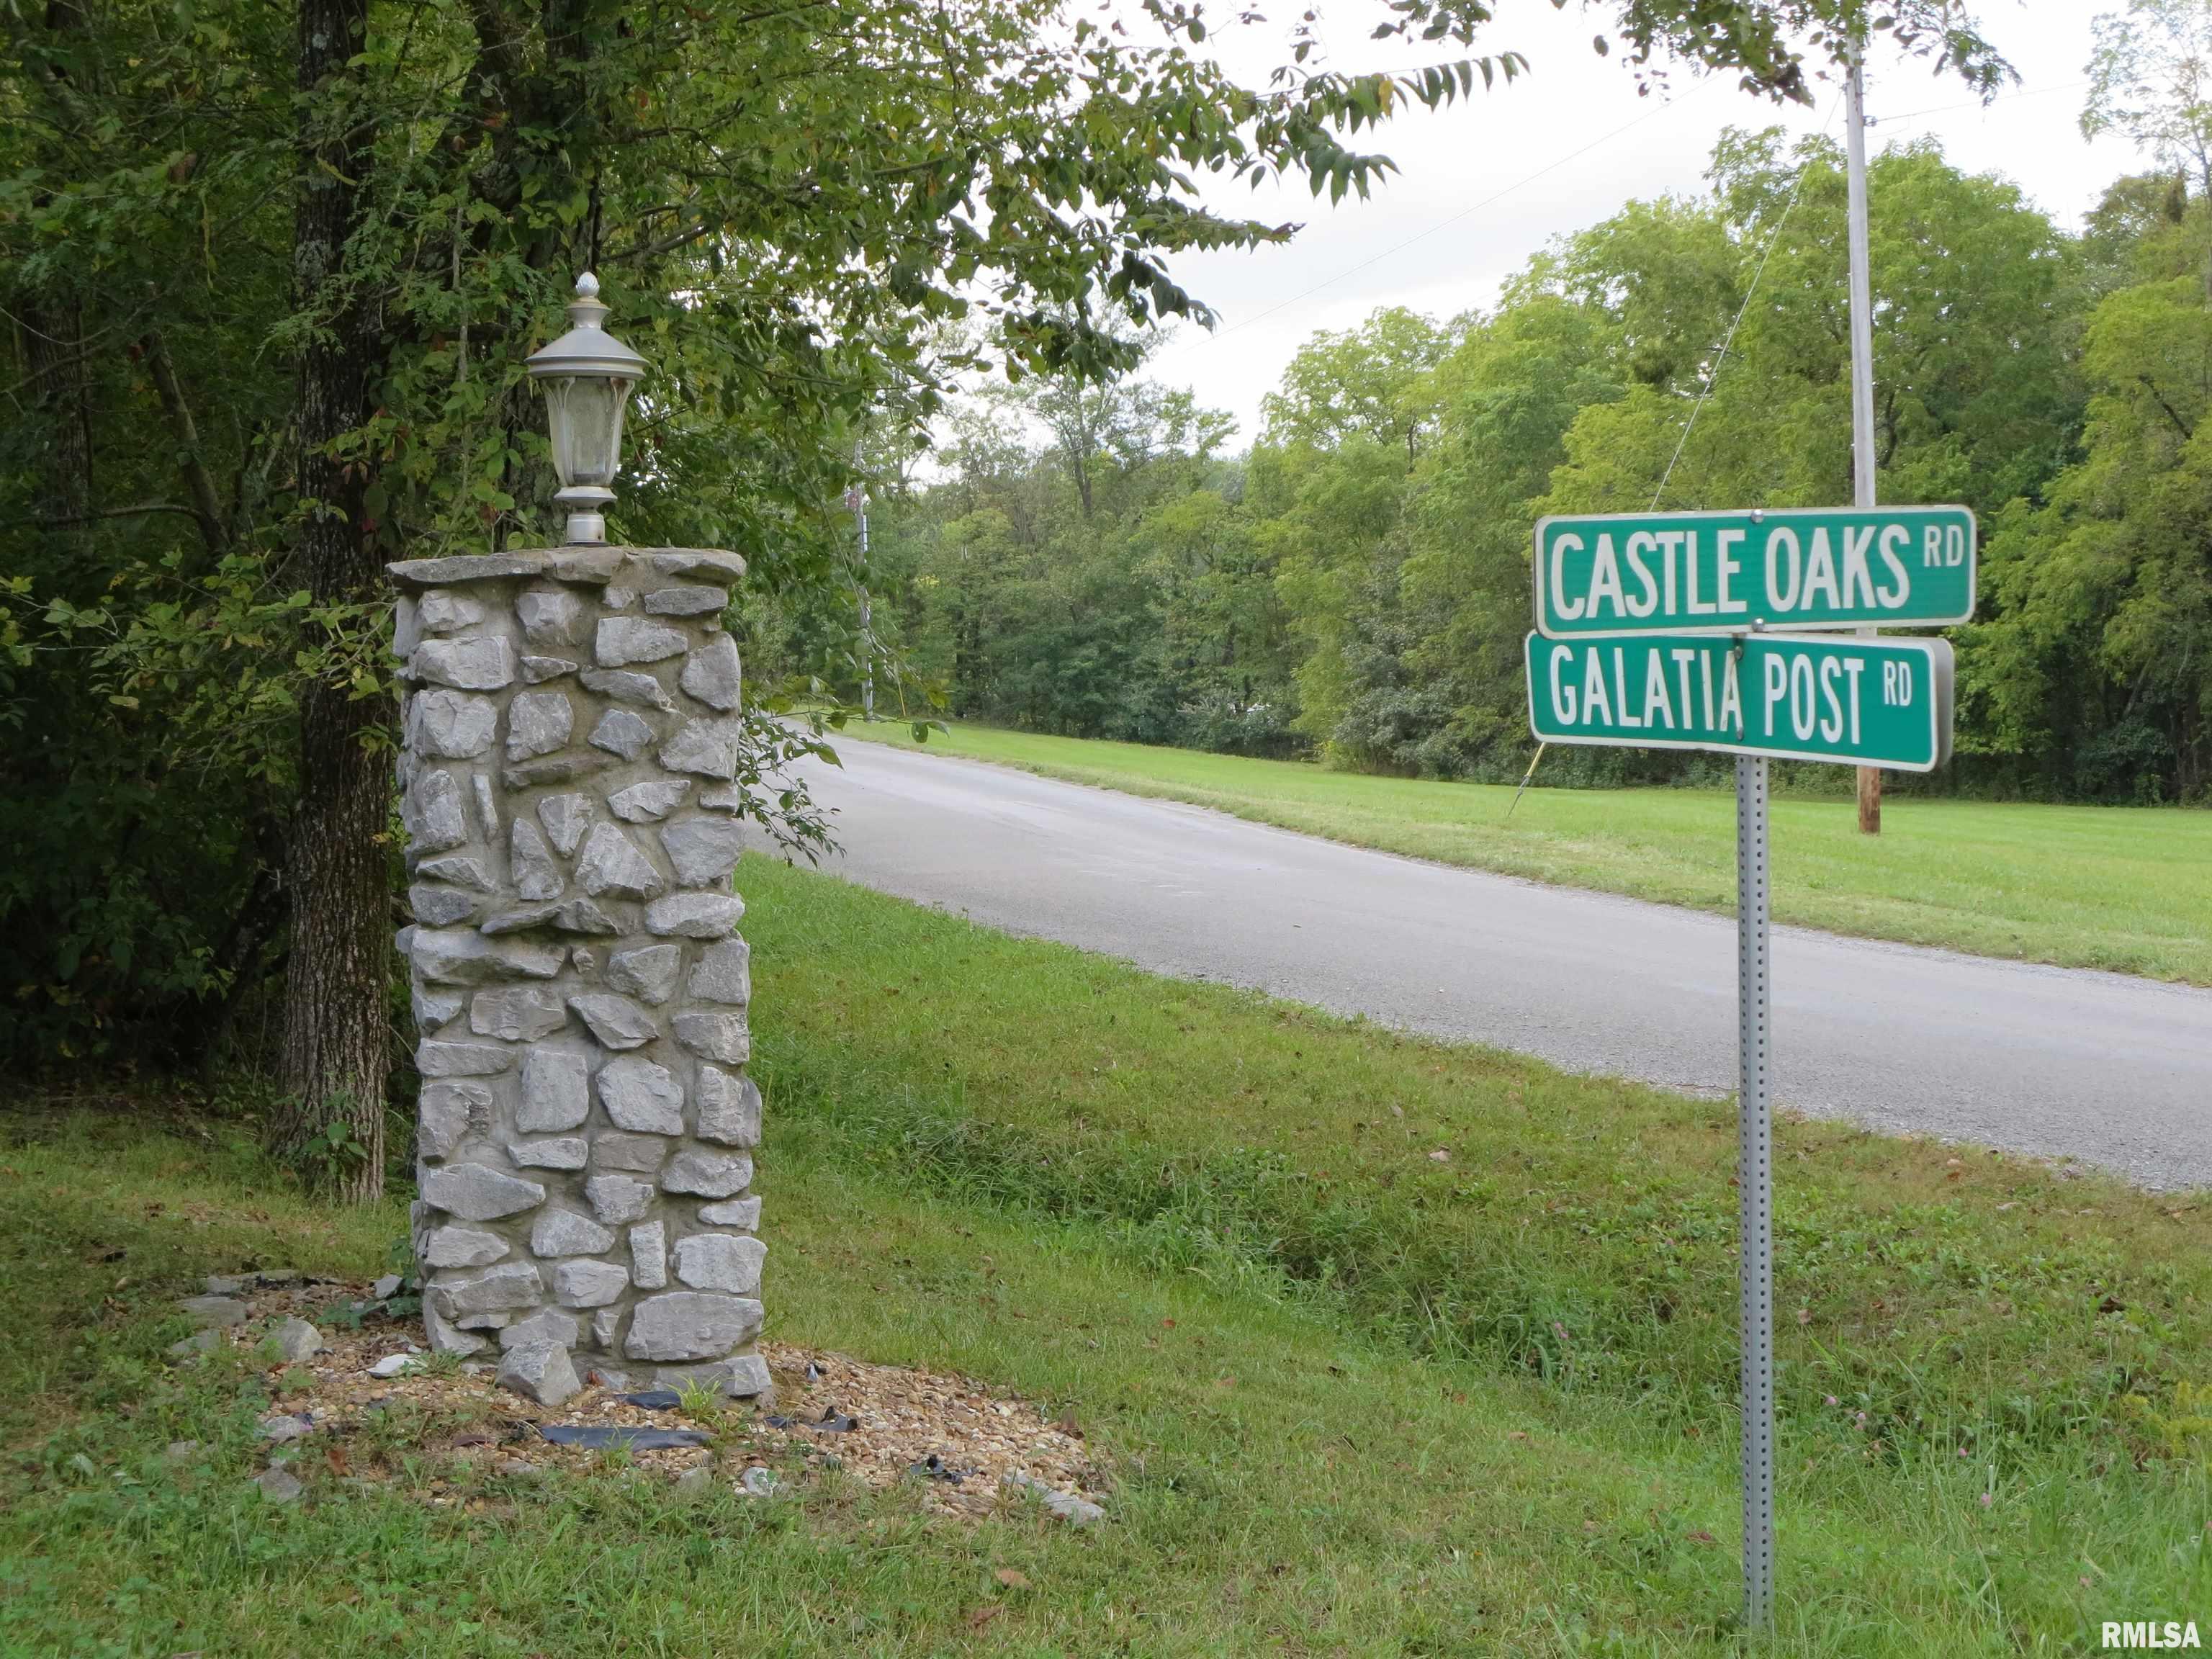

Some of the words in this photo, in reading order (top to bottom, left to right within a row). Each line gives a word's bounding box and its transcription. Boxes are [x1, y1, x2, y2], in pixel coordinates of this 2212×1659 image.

[1551, 529, 1747, 621] CASTLE
[1765, 524, 1911, 612] OAKS
[1923, 524, 1964, 567] RD
[1550, 644, 1745, 732] GALATIA
[1764, 653, 1864, 745] POST
[1884, 660, 1912, 706] RD
